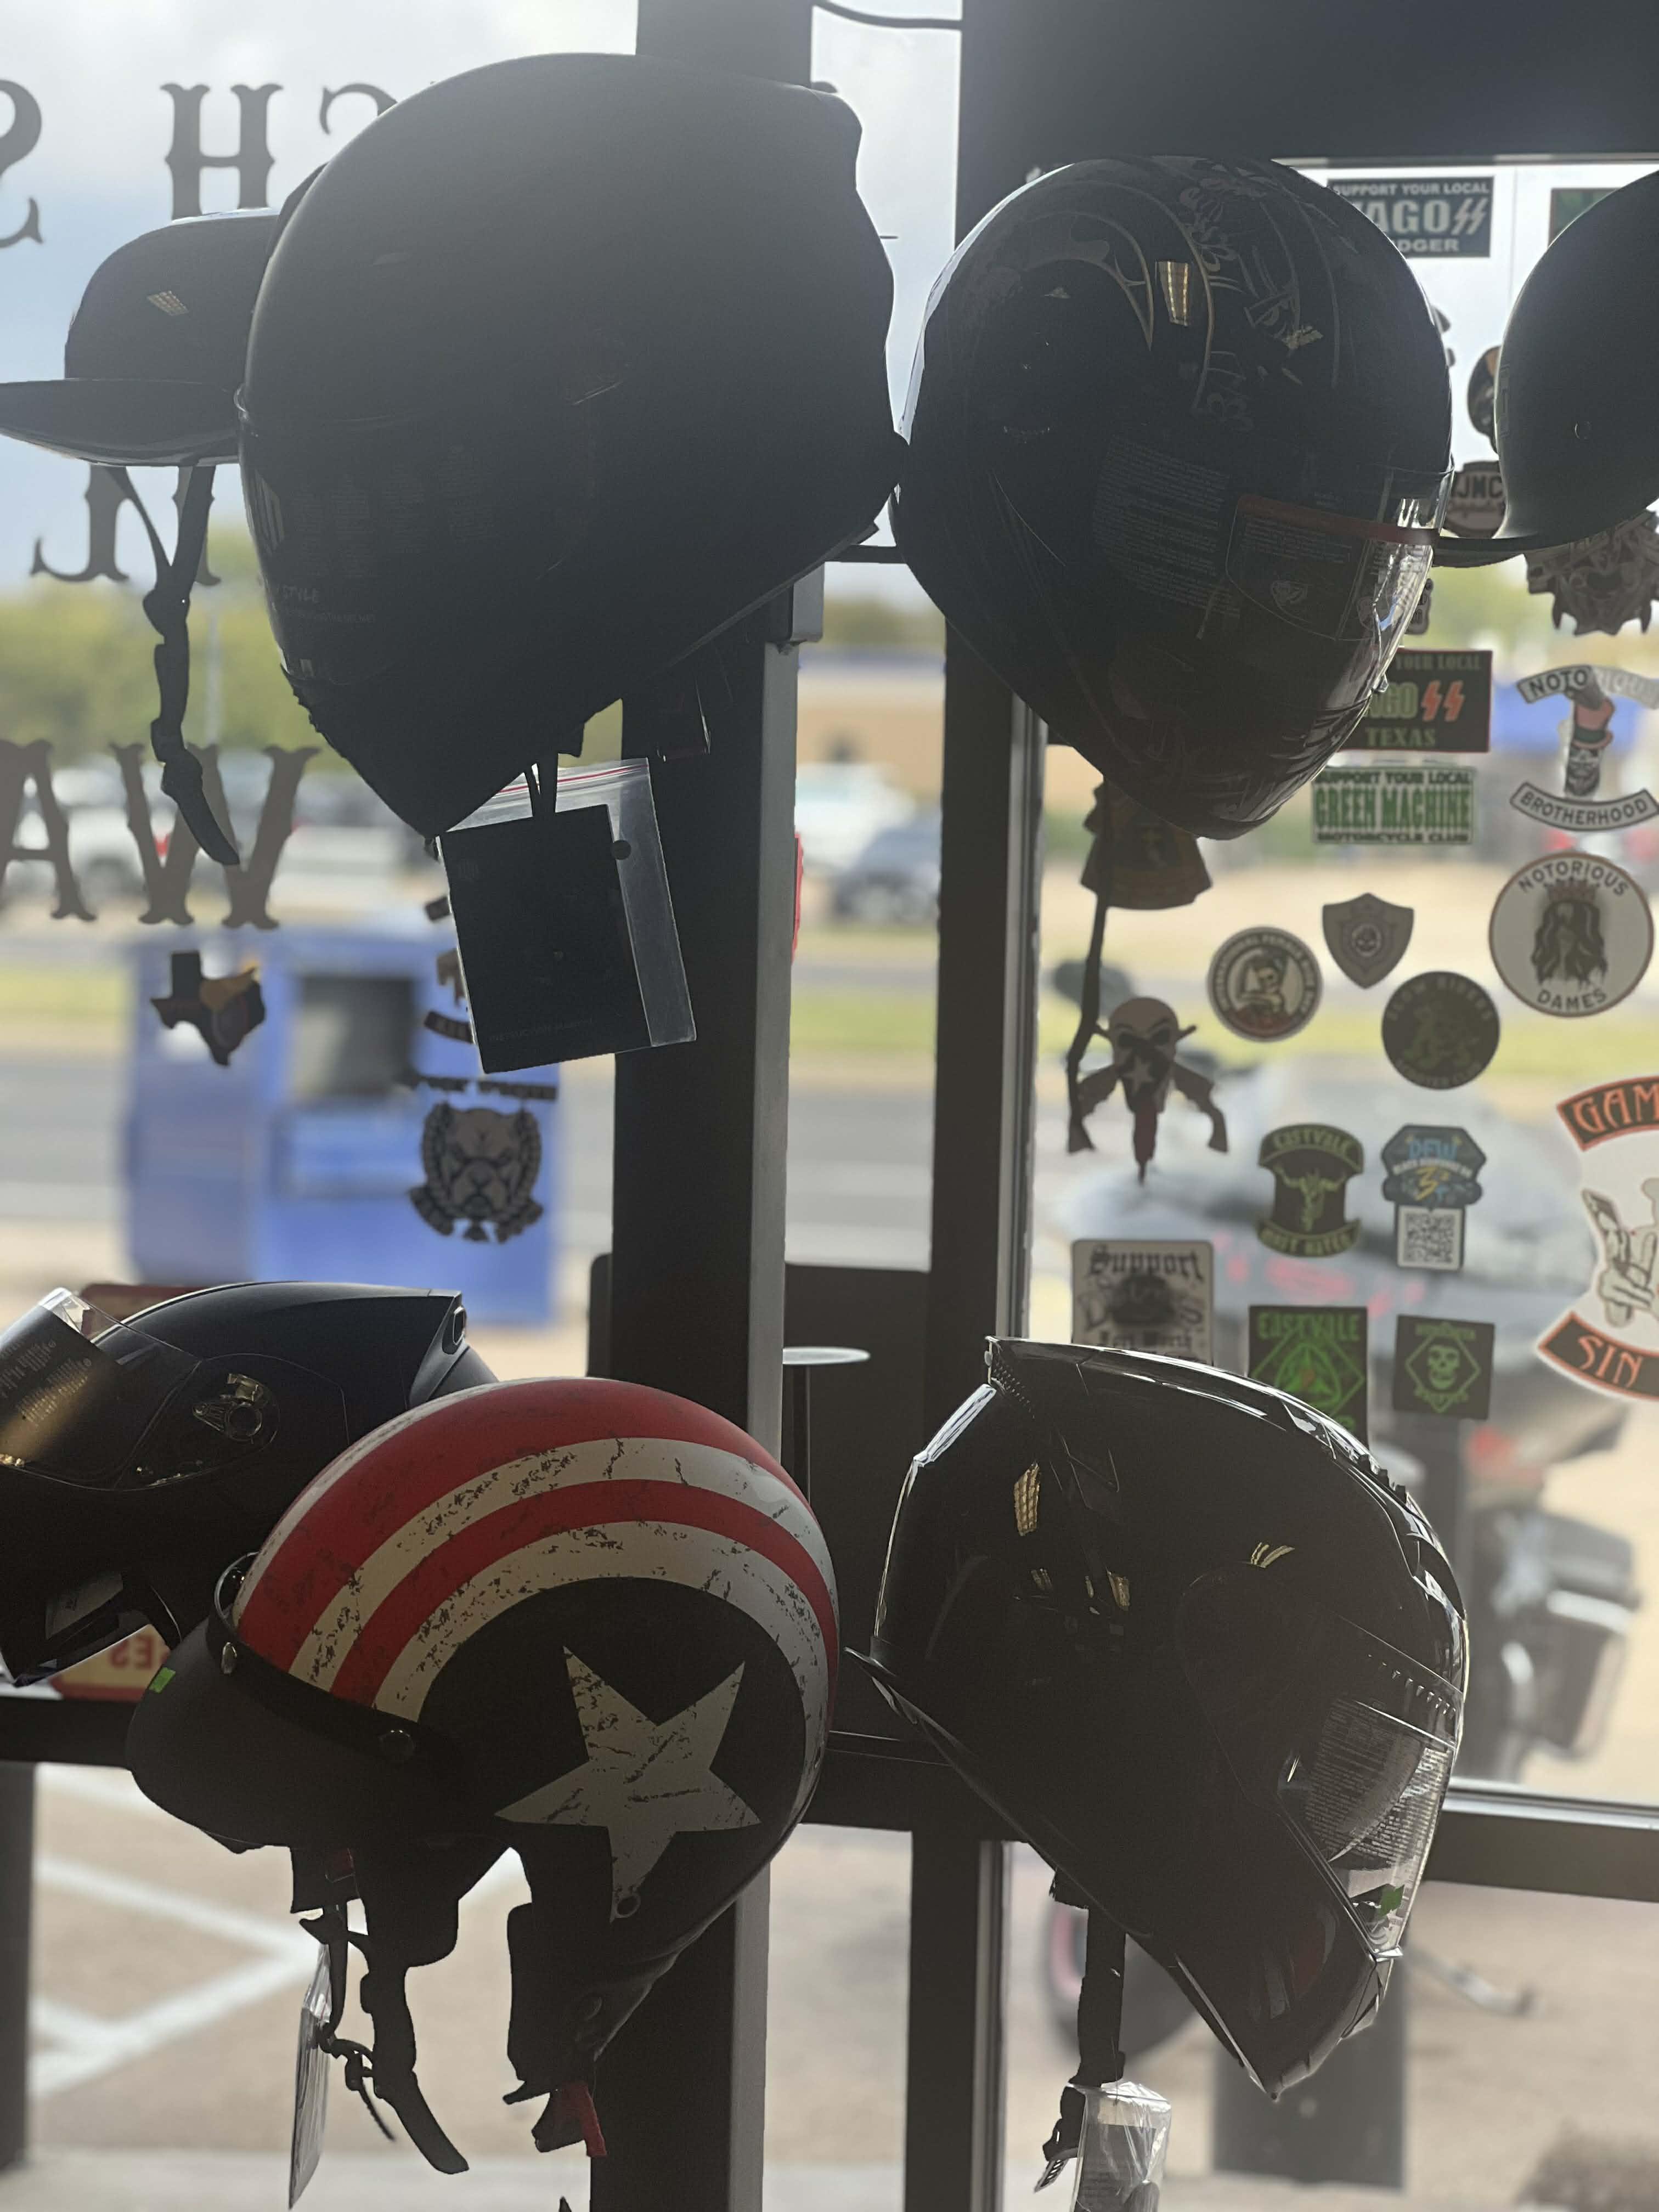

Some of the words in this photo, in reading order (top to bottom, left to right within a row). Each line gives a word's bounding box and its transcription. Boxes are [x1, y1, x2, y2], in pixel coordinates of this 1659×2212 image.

[1333, 184, 1397, 196] SUPPORT
[1402, 184, 1441, 195] YOUR
[1444, 183, 1489, 194] LOCAL
[1365, 727, 1436, 747] TEXAS
[1386, 770, 1425, 783] YOUR
[1429, 771, 1472, 783] LOCAL
[1316, 786, 1376, 828] GREEN
[1381, 787, 1471, 828] MACHINE
[1519, 791, 1649, 825] BROTHERHOOD
[1317, 833, 1424, 842] MOTORCYCLE
[1427, 833, 1469, 842] CLUB
[1519, 860, 1629, 896] NOTORIOUS
[1538, 988, 1607, 1011] DAMES
[1088, 1244, 1203, 1283] Support
[1577, 1333, 1644, 1388] SIN
